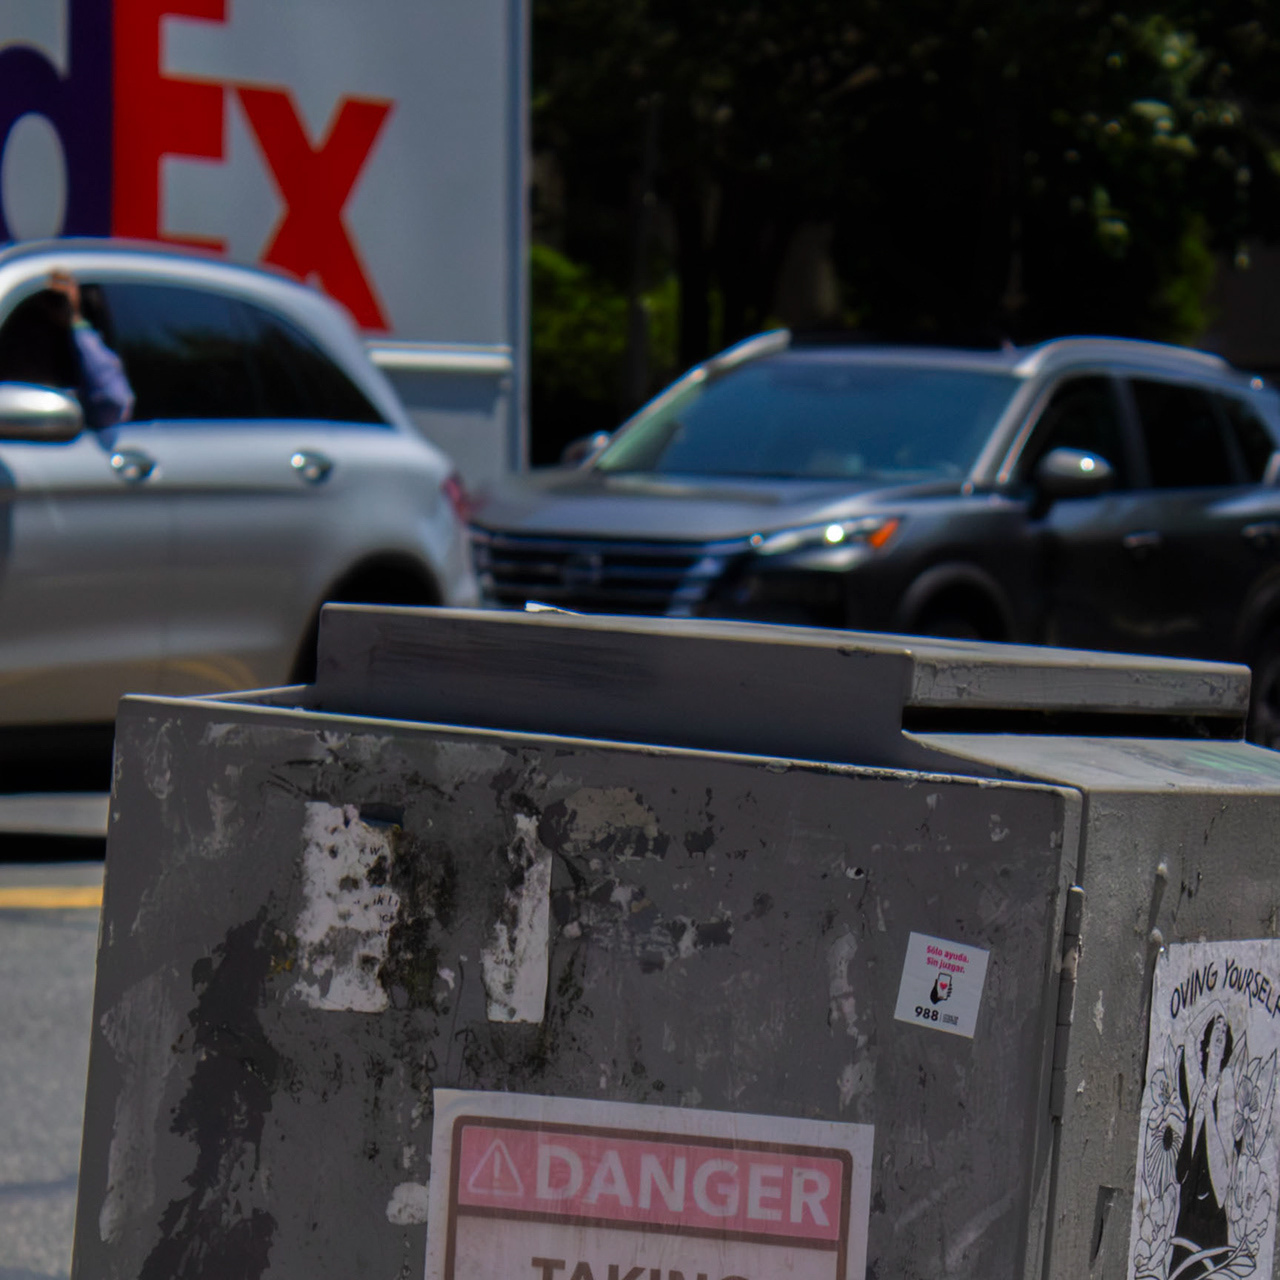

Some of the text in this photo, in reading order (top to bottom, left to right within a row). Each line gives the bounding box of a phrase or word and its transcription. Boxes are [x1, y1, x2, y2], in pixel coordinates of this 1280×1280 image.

[944, 950, 969, 963] ayuda.
[927, 957, 965, 973] Sin juzgar.
[915, 1006, 939, 1021] 988
[536, 1144, 832, 1227] DANGER
